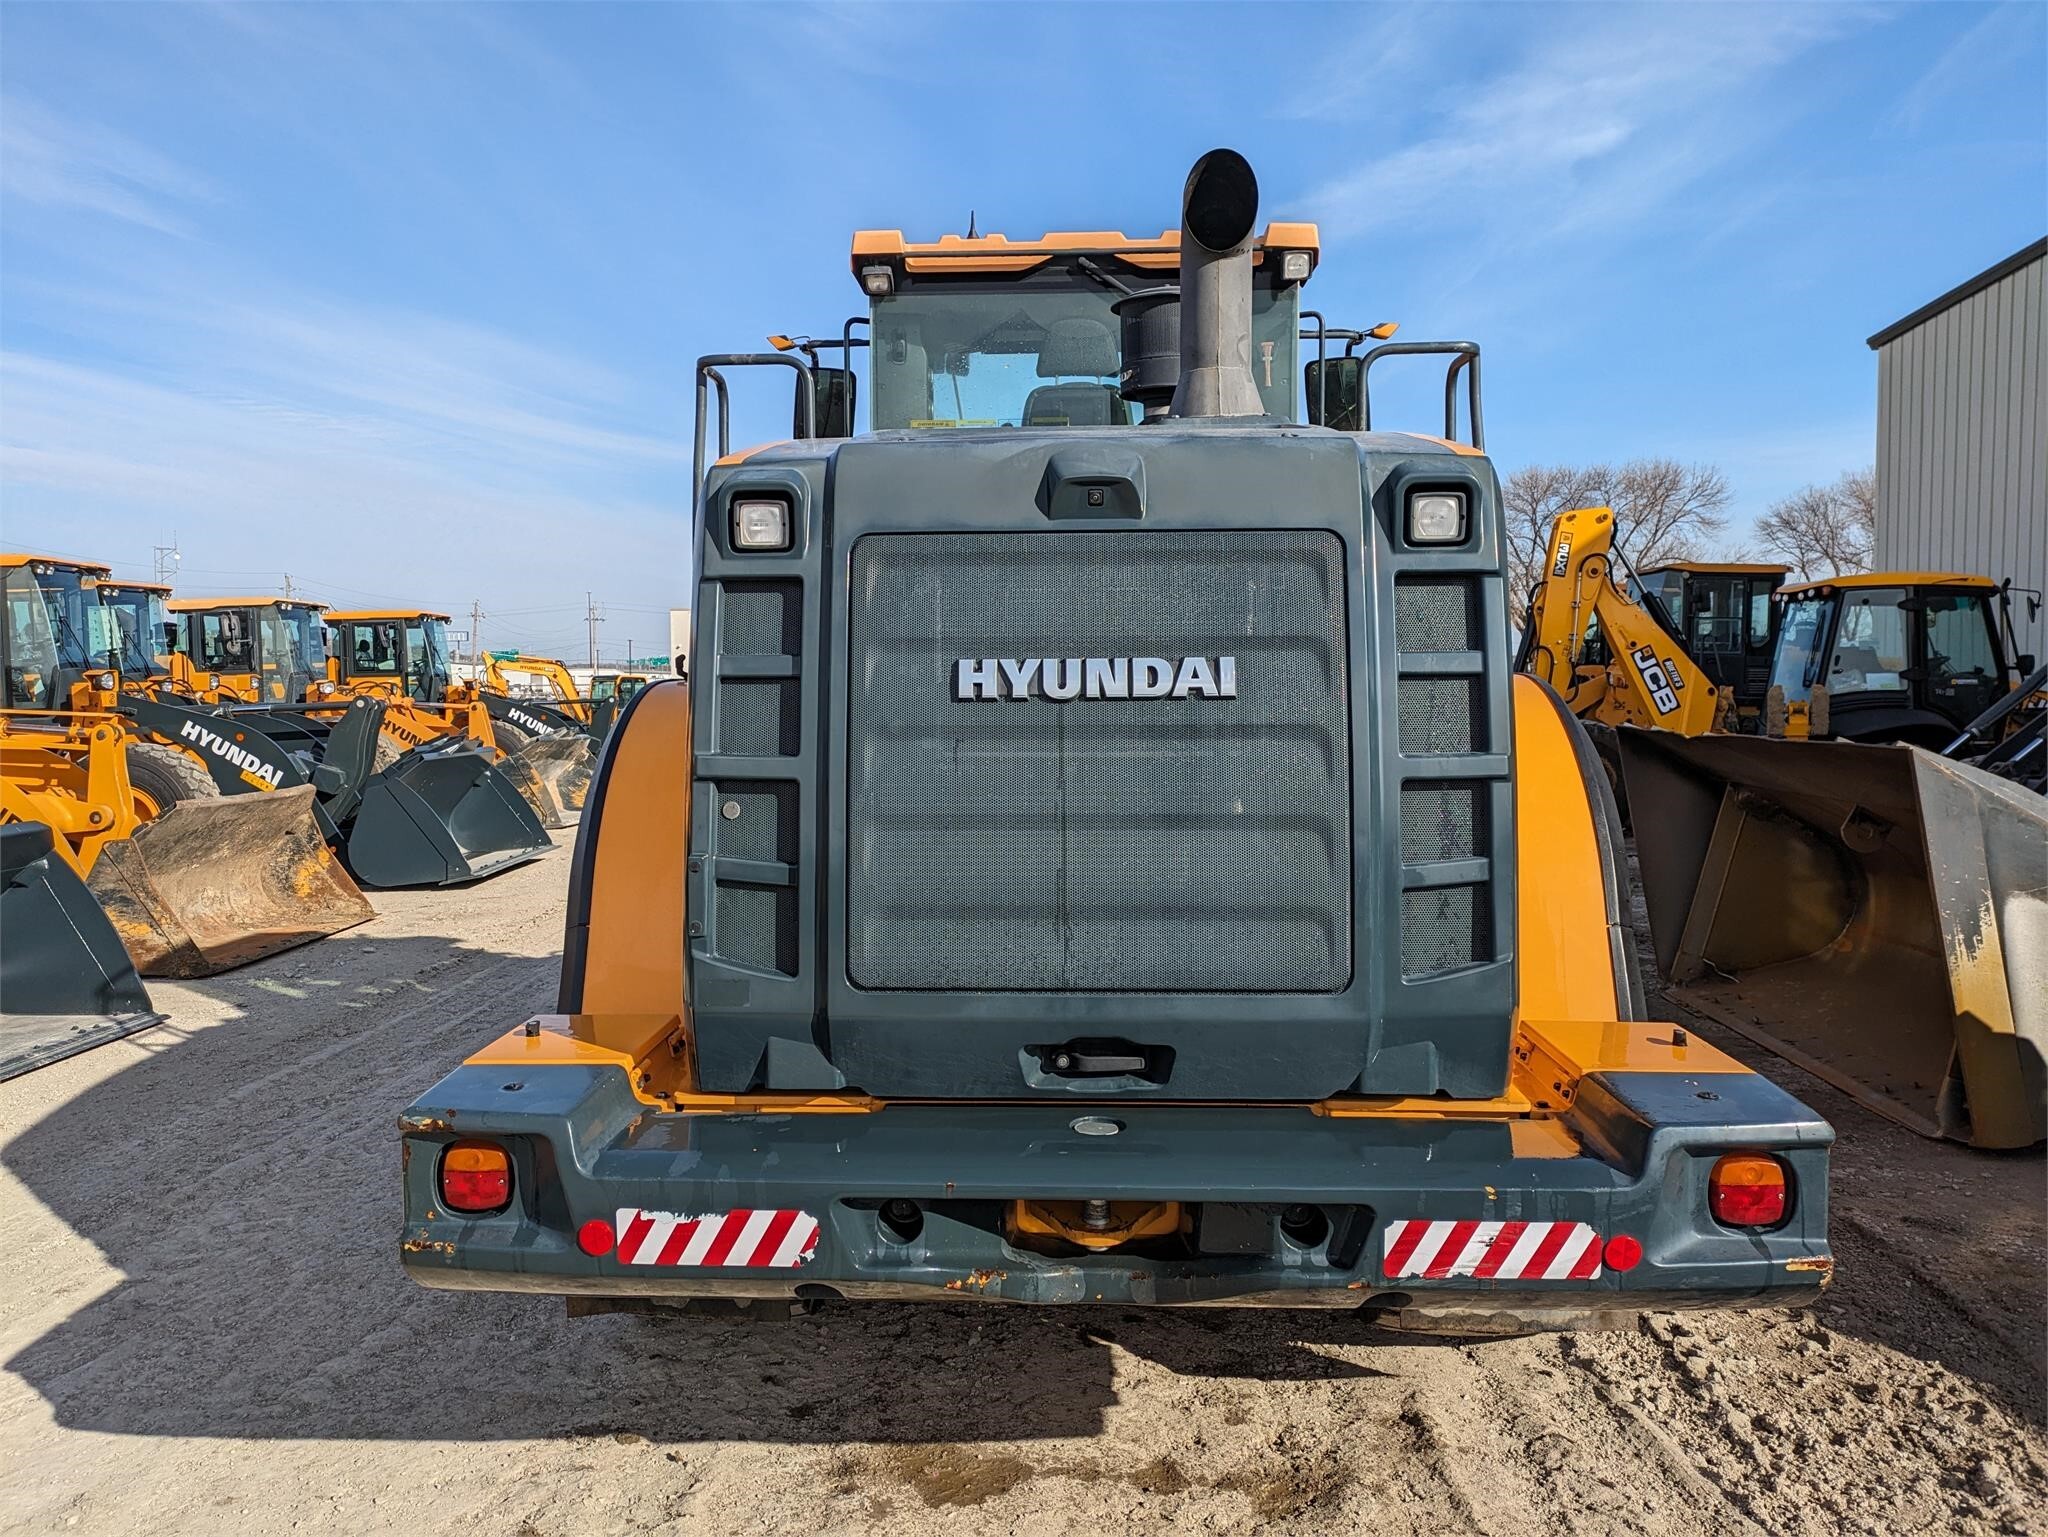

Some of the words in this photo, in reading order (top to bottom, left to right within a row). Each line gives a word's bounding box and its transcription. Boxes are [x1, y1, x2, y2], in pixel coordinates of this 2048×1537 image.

[957, 656, 1237, 699] HYUNDAI
[1633, 646, 1678, 713] JCB
[180, 720, 284, 786] HYUNDAI
[382, 718, 425, 746] HYUN
